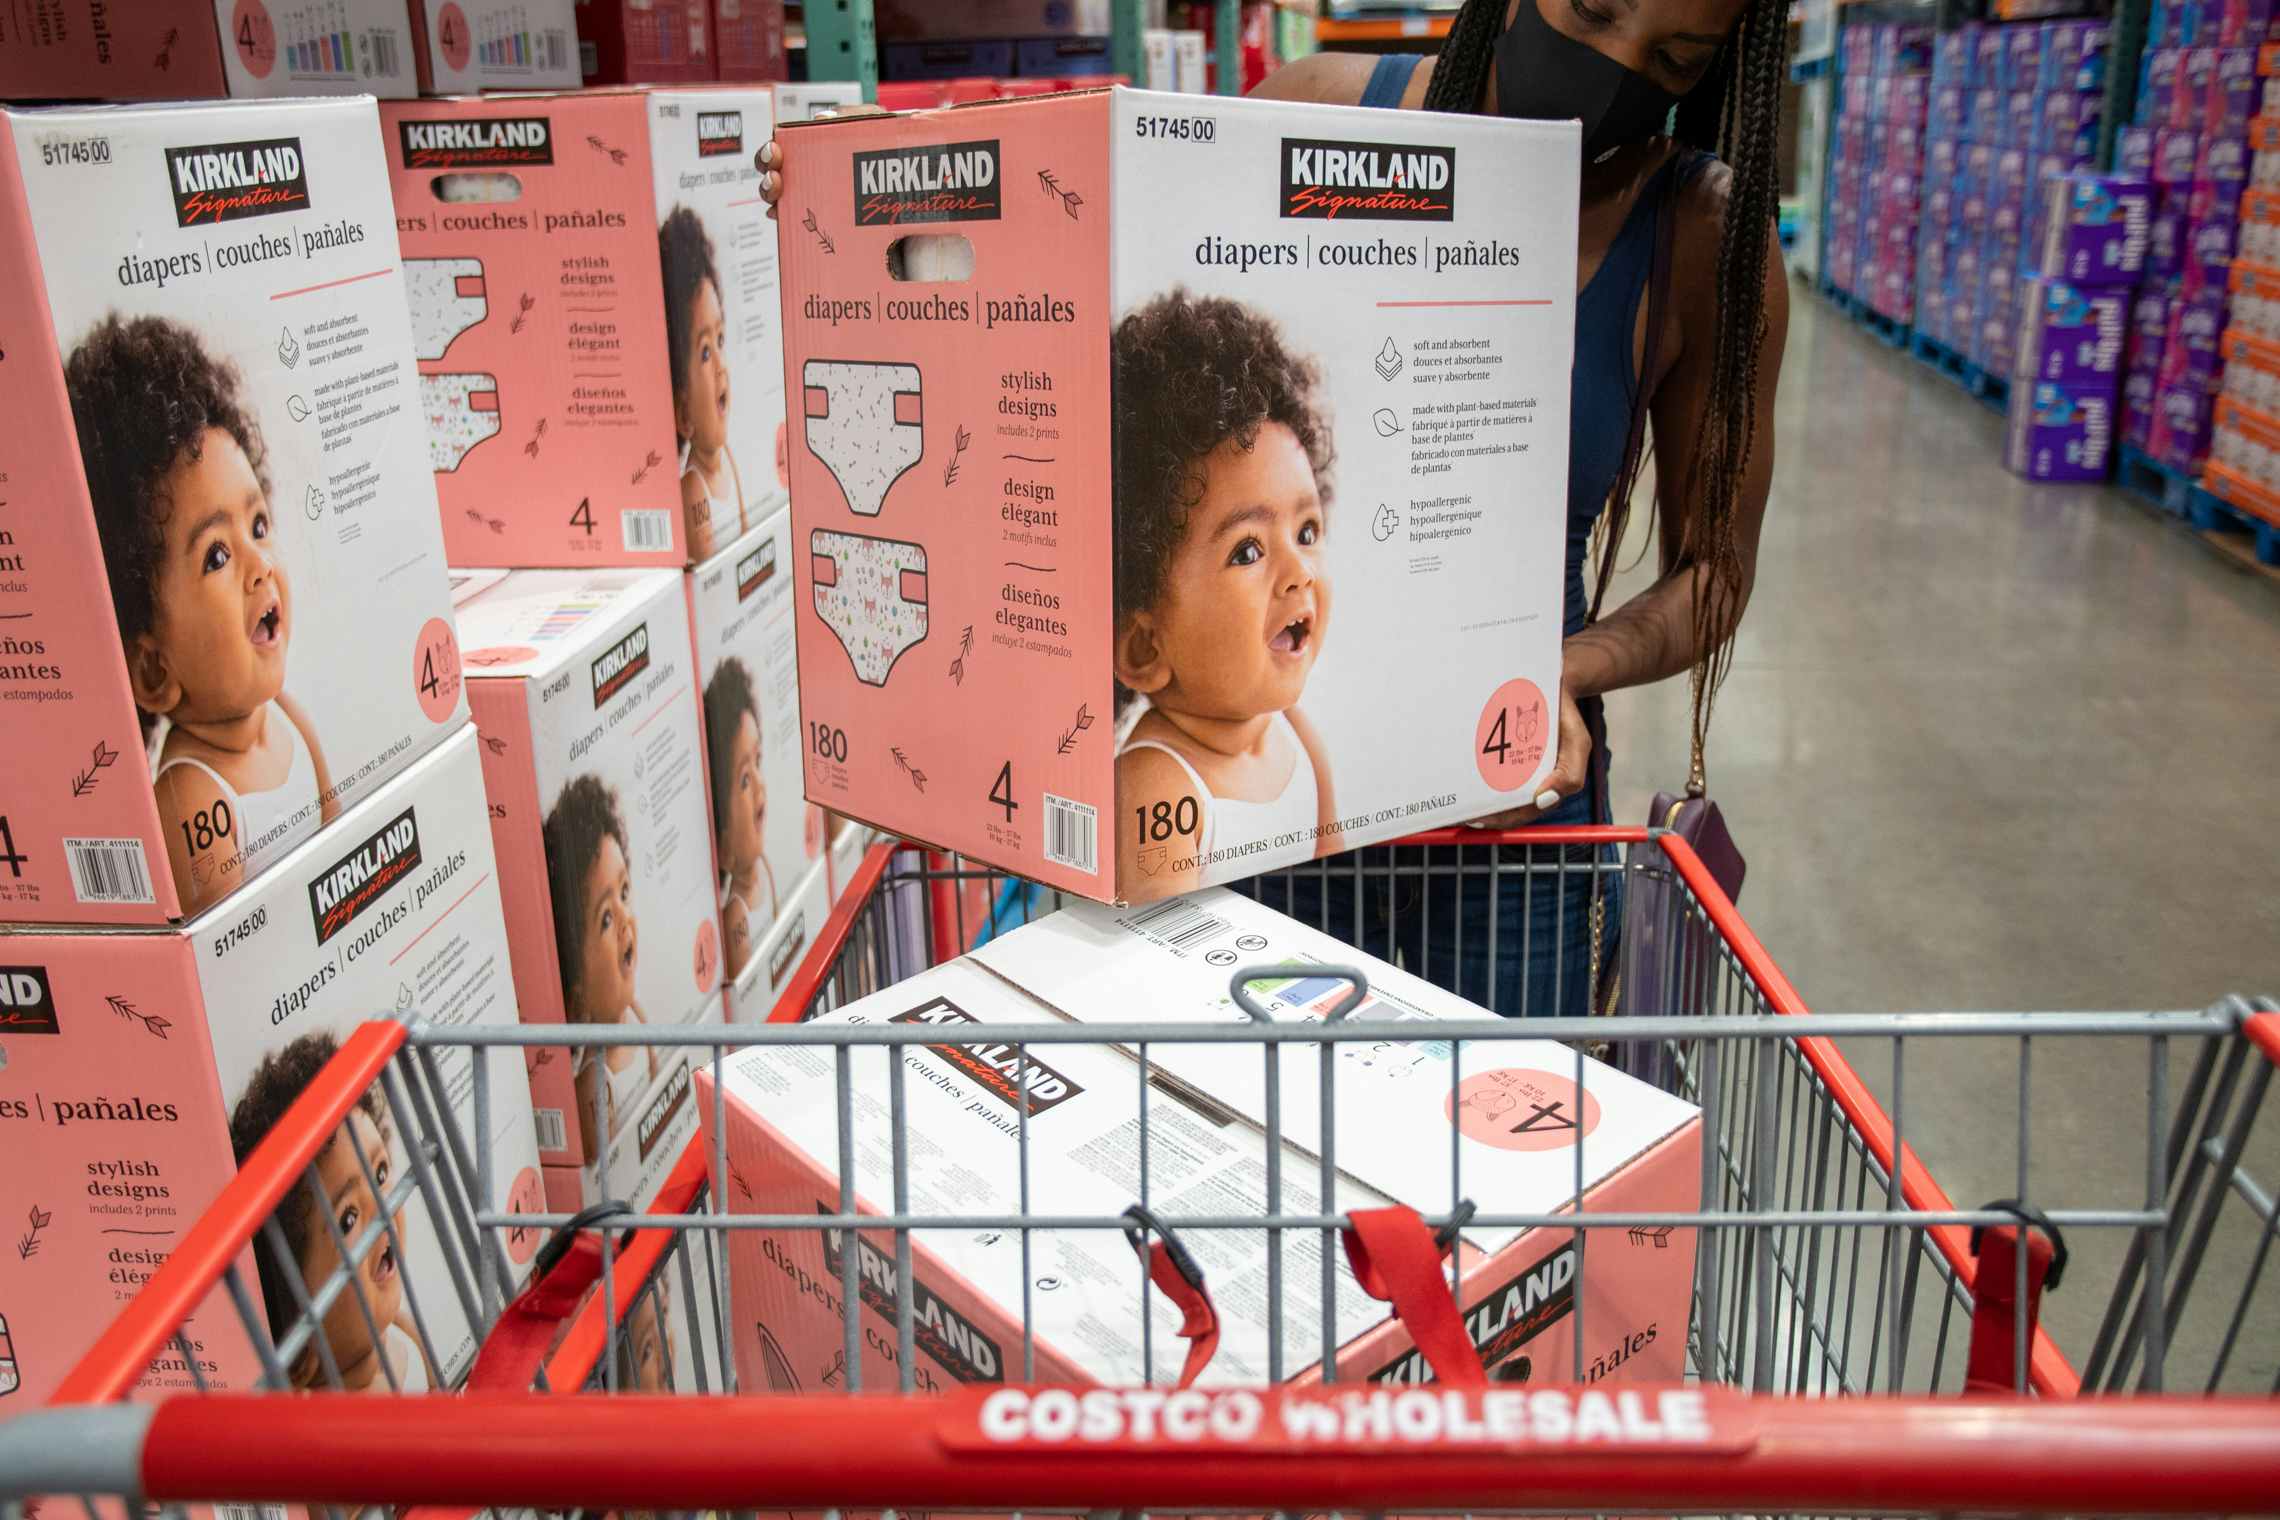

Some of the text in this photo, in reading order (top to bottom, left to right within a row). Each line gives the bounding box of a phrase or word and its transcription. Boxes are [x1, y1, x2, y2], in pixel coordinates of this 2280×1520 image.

[239, 14, 257, 56] 4
[441, 14, 456, 52] 4
[407, 121, 547, 151] KIRKLAND
[174, 146, 301, 195] KIRKLAND
[410, 149, 549, 168] Signature
[860, 150, 995, 195] KIRKLAND
[1291, 147, 1449, 190] KIRKLAND
[183, 188, 305, 225] Signature
[861, 192, 996, 225] Signature
[1290, 184, 1449, 220] Signature
[442, 212, 529, 233] couches
[544, 209, 627, 235] pañales
[117, 251, 202, 289] diapers
[215, 234, 293, 269] couches
[302, 220, 366, 257] pañales
[561, 256, 610, 272] stylish
[1194, 235, 1521, 273] diapers couches pañales
[560, 271, 616, 288] designs
[803, 293, 1075, 329] diapers couches pañales
[317, 320, 329, 333] and
[569, 321, 617, 338] design
[1413, 338, 1491, 351] soft and absorbent
[1413, 353, 1504, 368] douces et absorbantes
[1000, 370, 1053, 392] stylish
[1412, 373, 1438, 384] suave
[1443, 371, 1491, 384] absorbente
[567, 402, 635, 416] elegantes
[997, 394, 1057, 418] designs
[1412, 404, 1436, 416] made
[1435, 402, 1456, 415] with
[1501, 398, 1537, 410] materials
[996, 423, 1028, 438] includes
[1035, 426, 1060, 441] prints
[1411, 430, 1475, 445] base de plantes
[1456, 417, 1481, 431] partir
[1481, 415, 1492, 427] de
[1411, 448, 1450, 462] fabricado
[1450, 449, 1466, 459] con
[1465, 443, 1506, 458] materiales
[1512, 441, 1530, 453] base
[1410, 462, 1453, 477] de plantas
[1003, 477, 1055, 502] design
[1410, 494, 1472, 512] hypoallergenic
[569, 496, 599, 536] 4
[1000, 502, 1059, 528] élégant
[1009, 529, 1034, 547] motifs
[1034, 532, 1058, 547] inclus
[1001, 582, 1061, 610] diseños
[994, 607, 1068, 637] elegantes
[594, 627, 647, 689] KIRKLAND
[991, 632, 1019, 652] incluye
[1025, 639, 1073, 659] estampados
[420, 647, 440, 700] 4
[4, 690, 73, 702] estampados
[568, 724, 605, 763] diapers
[608, 689, 643, 729] couches
[1482, 707, 1512, 765] 4
[810, 720, 848, 763] 180
[988, 760, 1019, 823] 4
[181, 799, 232, 857] 180
[1135, 795, 1200, 845] 180
[1208, 850, 1226, 865] 180
[1226, 841, 1269, 863] DIAPERS
[1324, 815, 1371, 837] COUCHES
[1405, 802, 1420, 818] 180
[1419, 793, 1458, 814] PAÑALES
[258, 822, 287, 852] DIAPERS
[315, 818, 416, 916] KIRKLAND
[321, 853, 418, 942] Signature
[269, 849, 468, 1027] diapers couches pañales
[1265, 1001, 1285, 1013] 5
[904, 1055, 966, 1100] couches
[53, 1095, 180, 1126] pañales
[1508, 1101, 1579, 1134] 4
[87, 1160, 161, 1180] stylish
[87, 1181, 171, 1202] designs
[89, 1203, 177, 1218] includes 2 prints
[762, 1237, 847, 1321] diapers
[979, 1389, 1262, 1441] COSTCO
